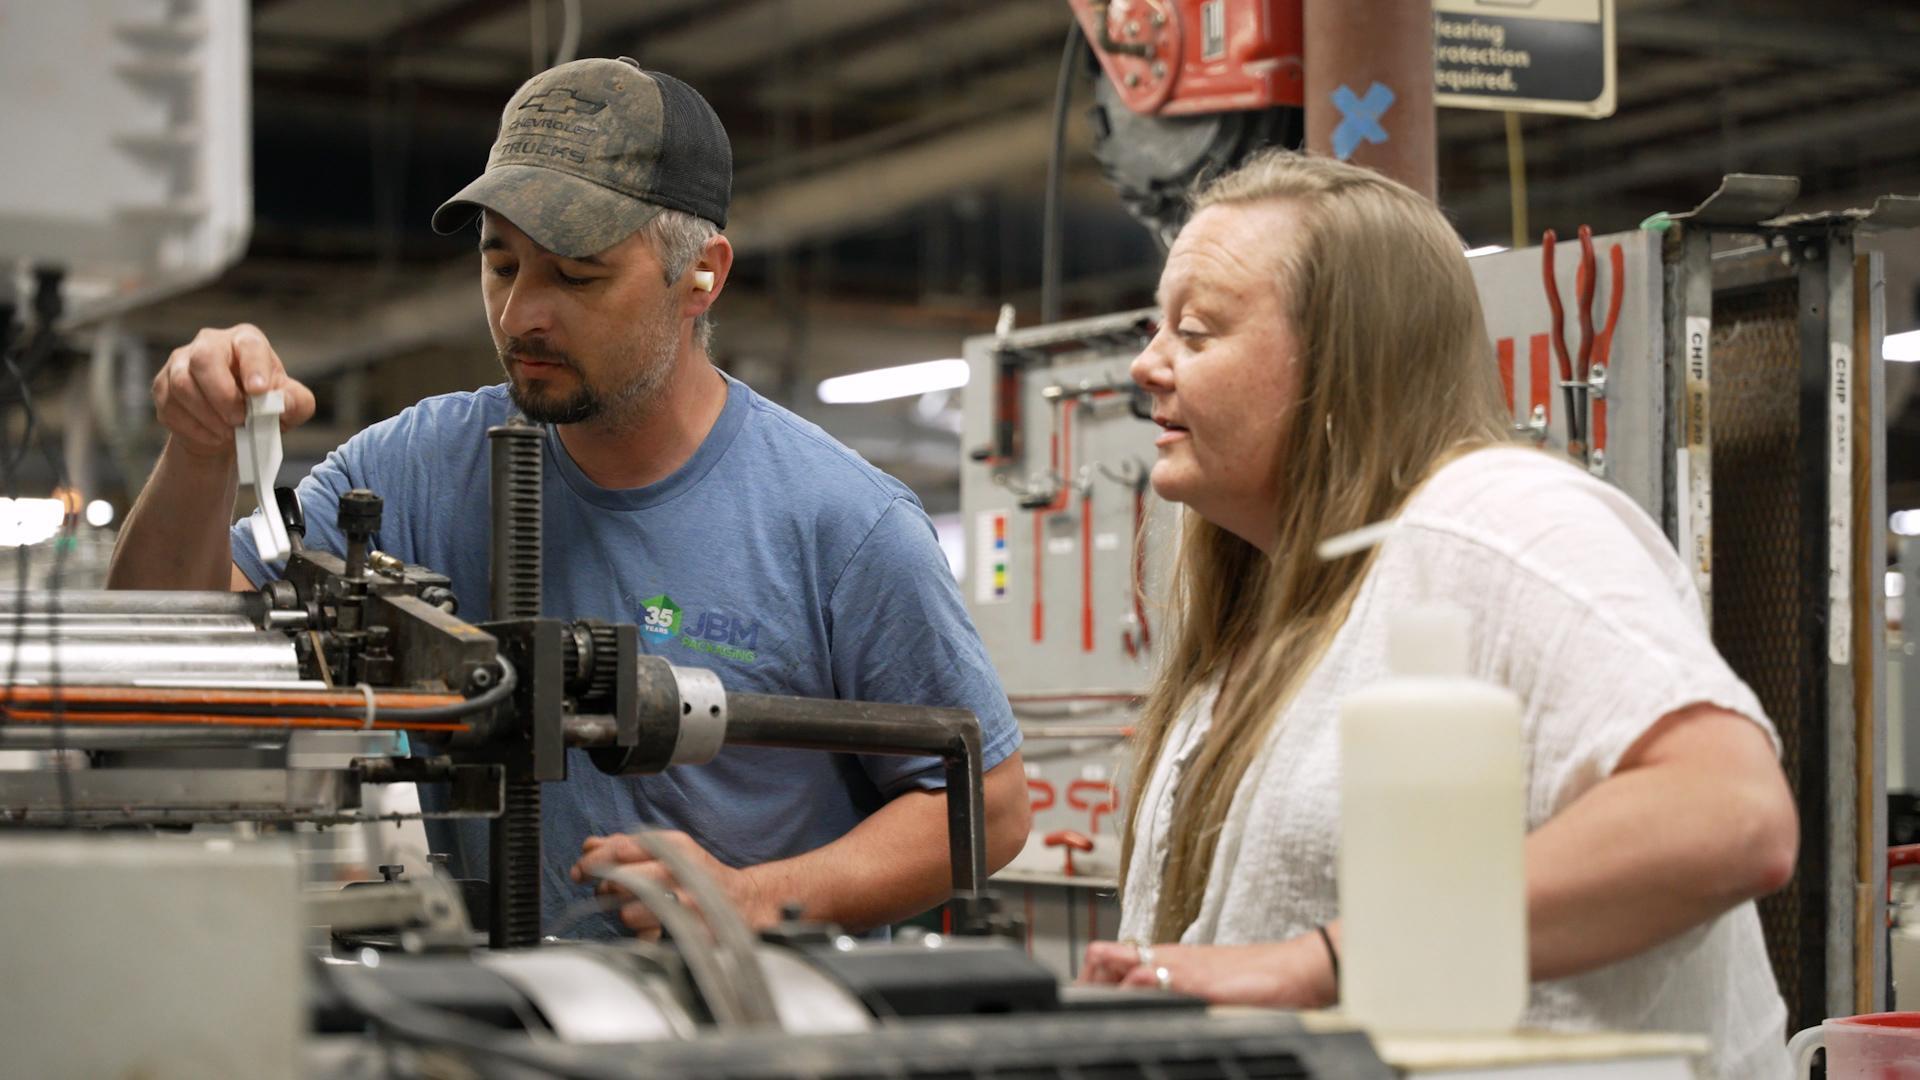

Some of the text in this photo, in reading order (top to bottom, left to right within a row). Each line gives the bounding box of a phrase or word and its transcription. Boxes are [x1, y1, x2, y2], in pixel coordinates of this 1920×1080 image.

[1435, 45, 1531, 68] rotection
[1435, 68, 1518, 91] equired.
[509, 118, 597, 136] CHEVROLET
[501, 141, 586, 164] TRUCKS
[1691, 332, 1703, 380] CHIP
[1836, 358, 1847, 405] CHIP
[644, 606, 674, 628] 35
[645, 625, 669, 635] YEARS
[684, 611, 760, 650] JBM
